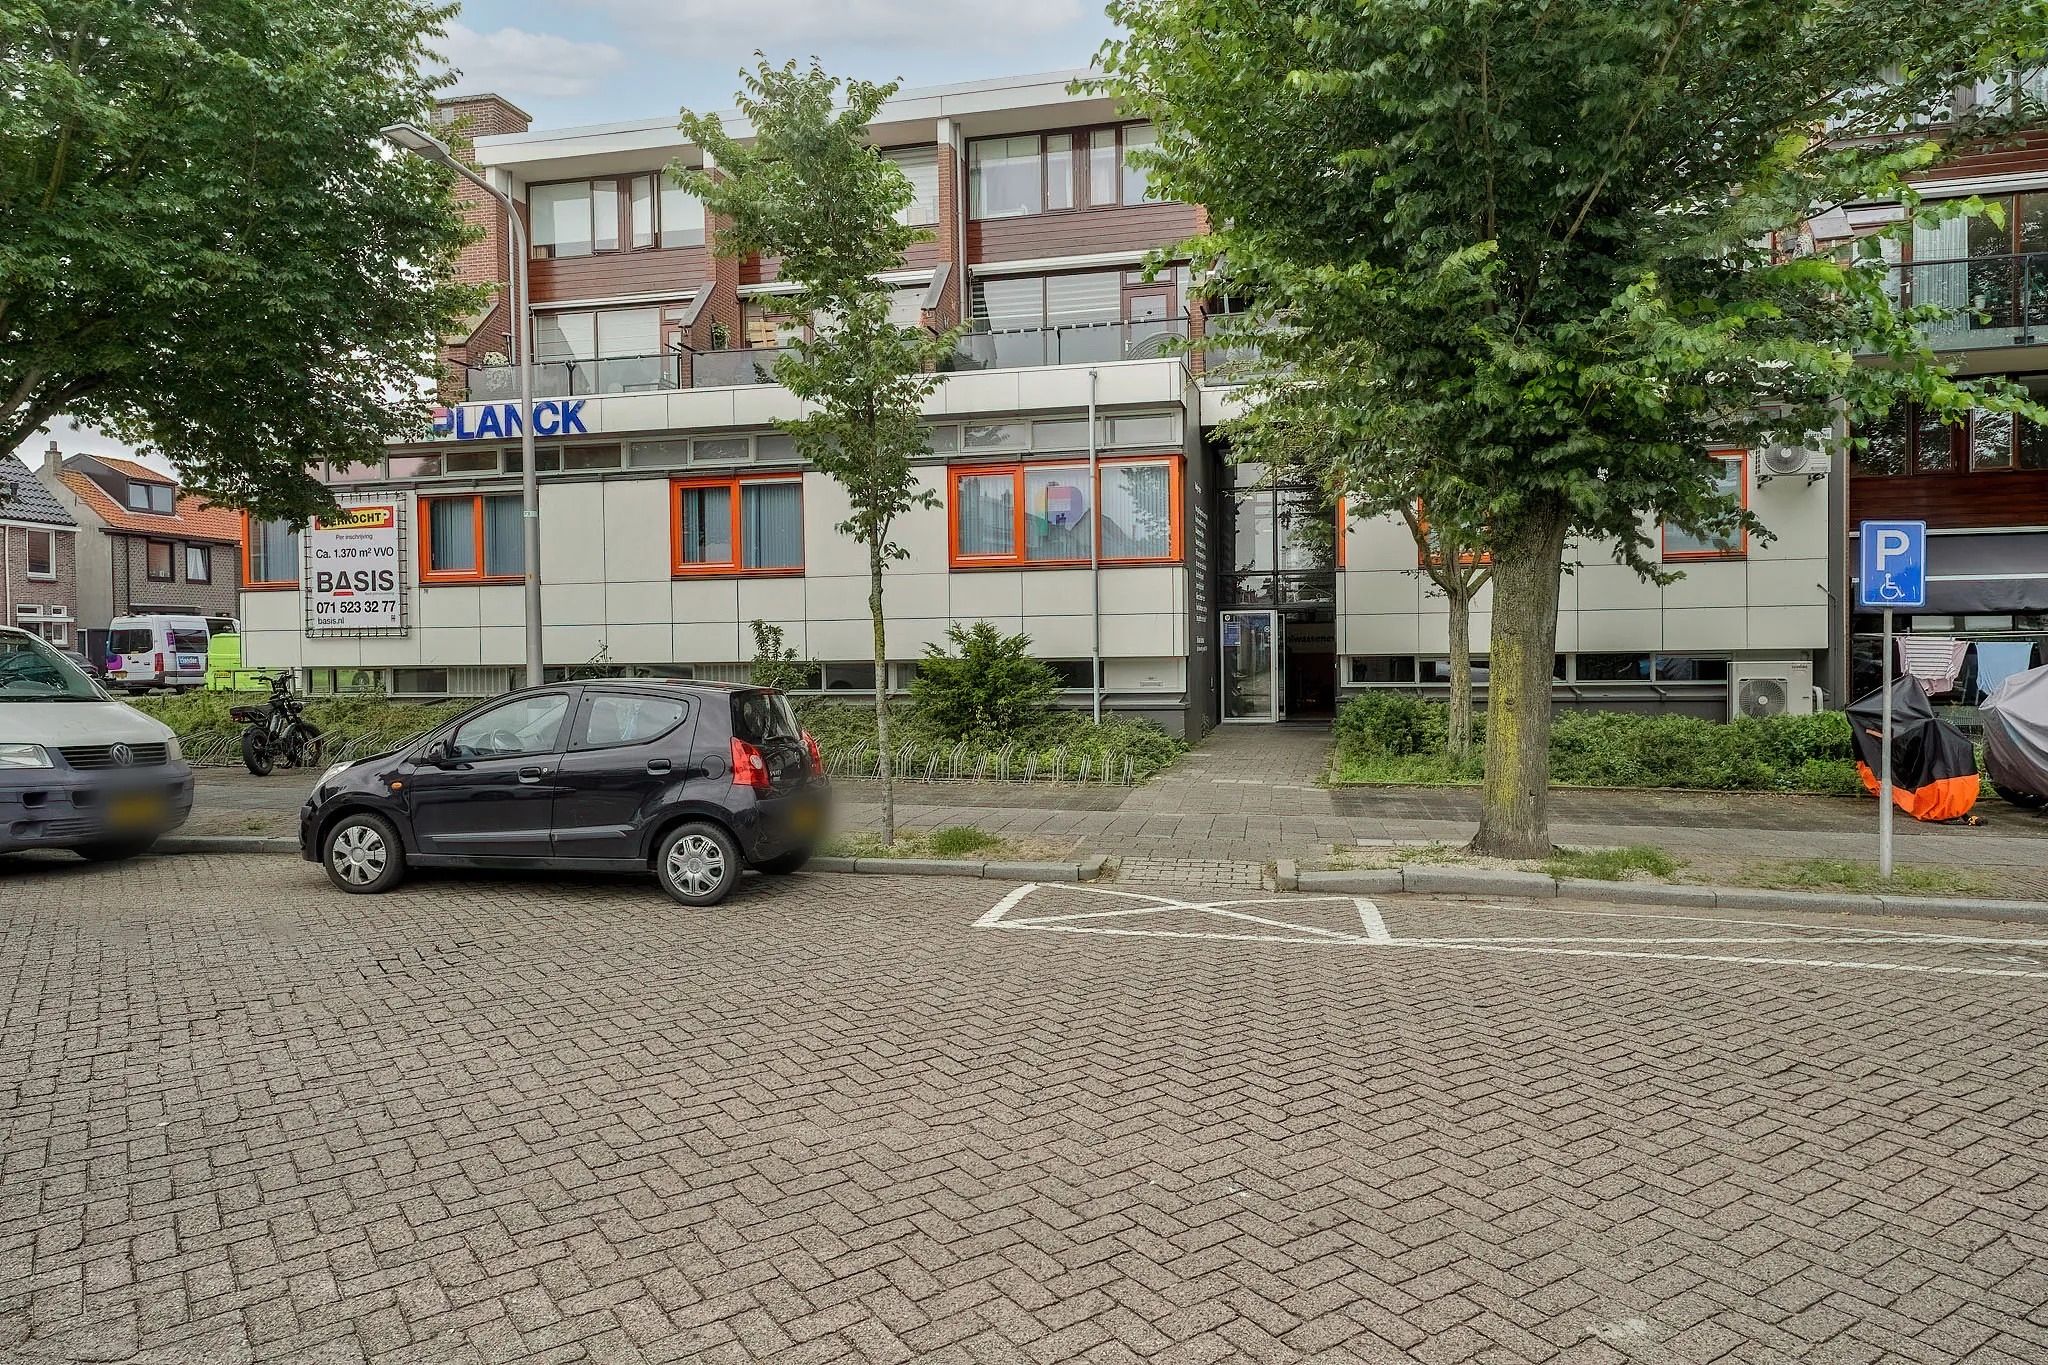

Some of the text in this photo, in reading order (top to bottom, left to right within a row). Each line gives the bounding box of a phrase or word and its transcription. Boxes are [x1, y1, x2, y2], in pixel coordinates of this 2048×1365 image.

[316, 549, 332, 559] Ca.
[334, 548, 357, 559] 1.370
[373, 546, 394, 557] VVO
[1876, 529, 1910, 571] P
[317, 569, 394, 593] BASIS
[316, 600, 396, 614] 071 523 32 77
[317, 616, 345, 625] basis.nl
